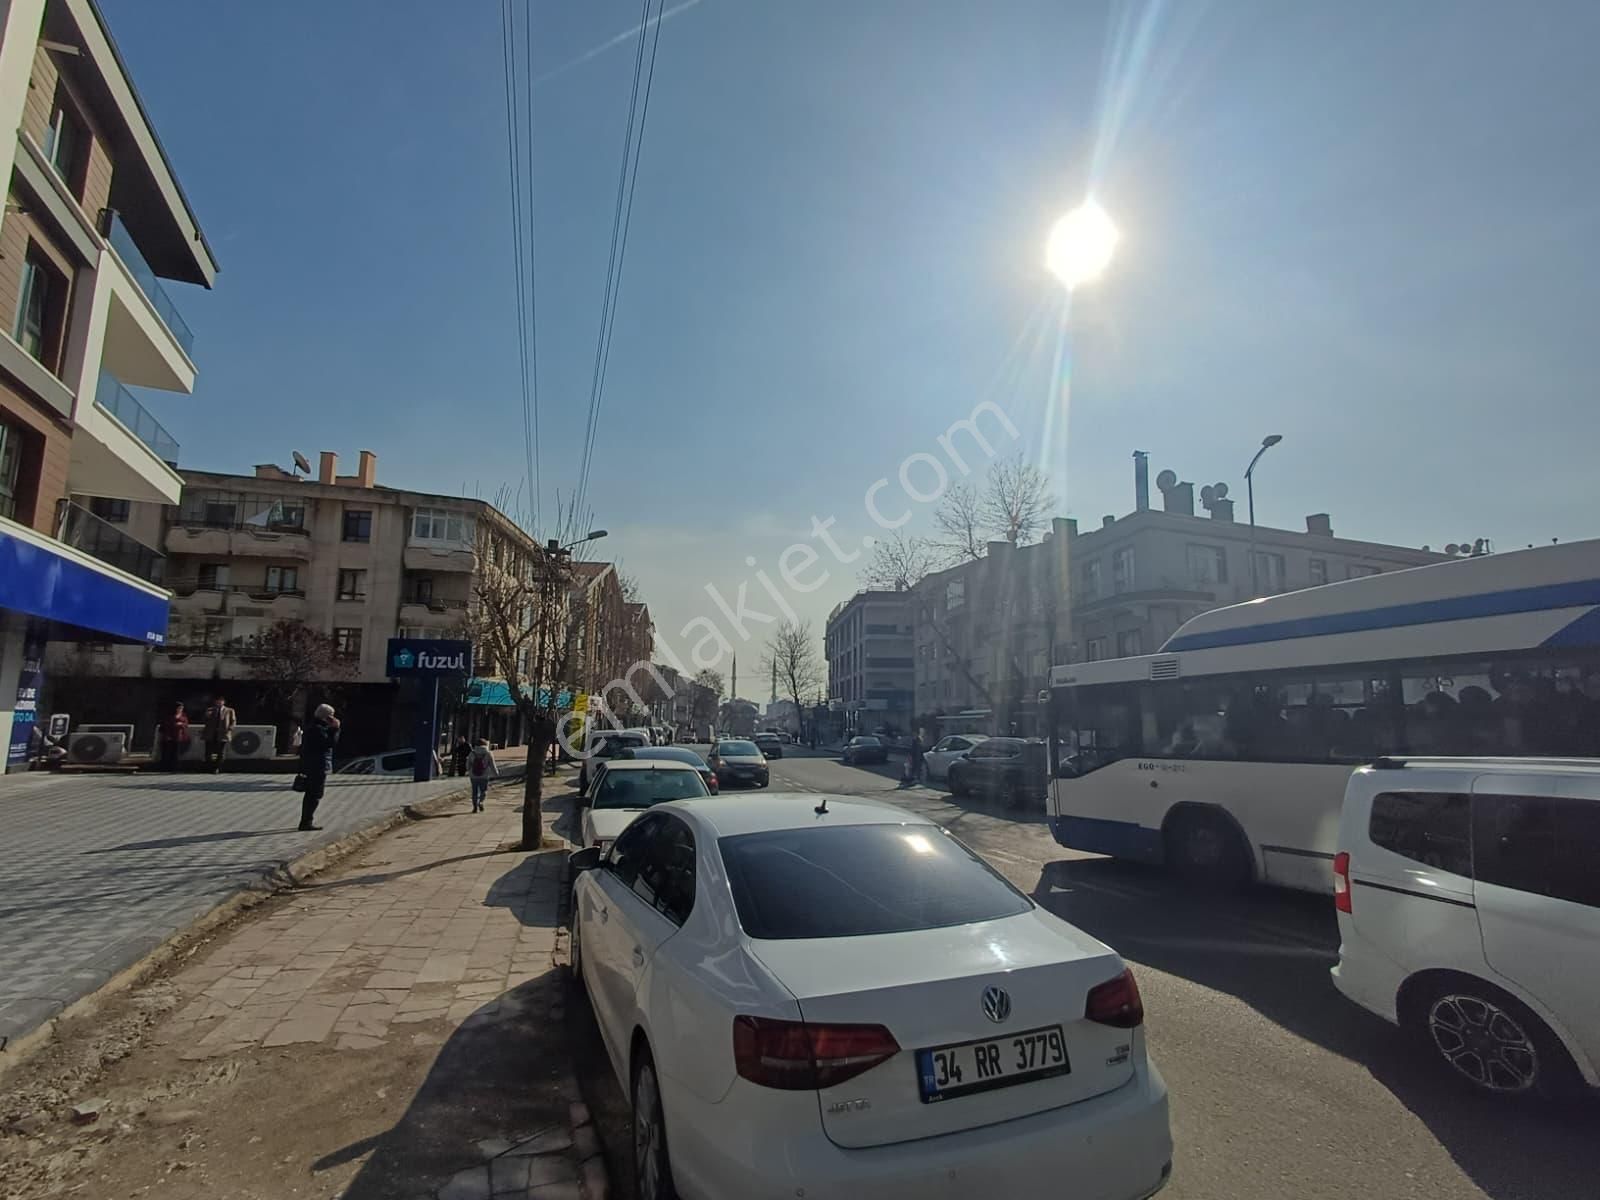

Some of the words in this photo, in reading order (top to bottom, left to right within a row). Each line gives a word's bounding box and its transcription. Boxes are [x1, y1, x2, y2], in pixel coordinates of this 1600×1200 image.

[417, 651, 465, 669] fuzul
[934, 1051, 962, 1086] 34
[974, 1043, 1003, 1078] RR
[1013, 1032, 1062, 1070] 3779
